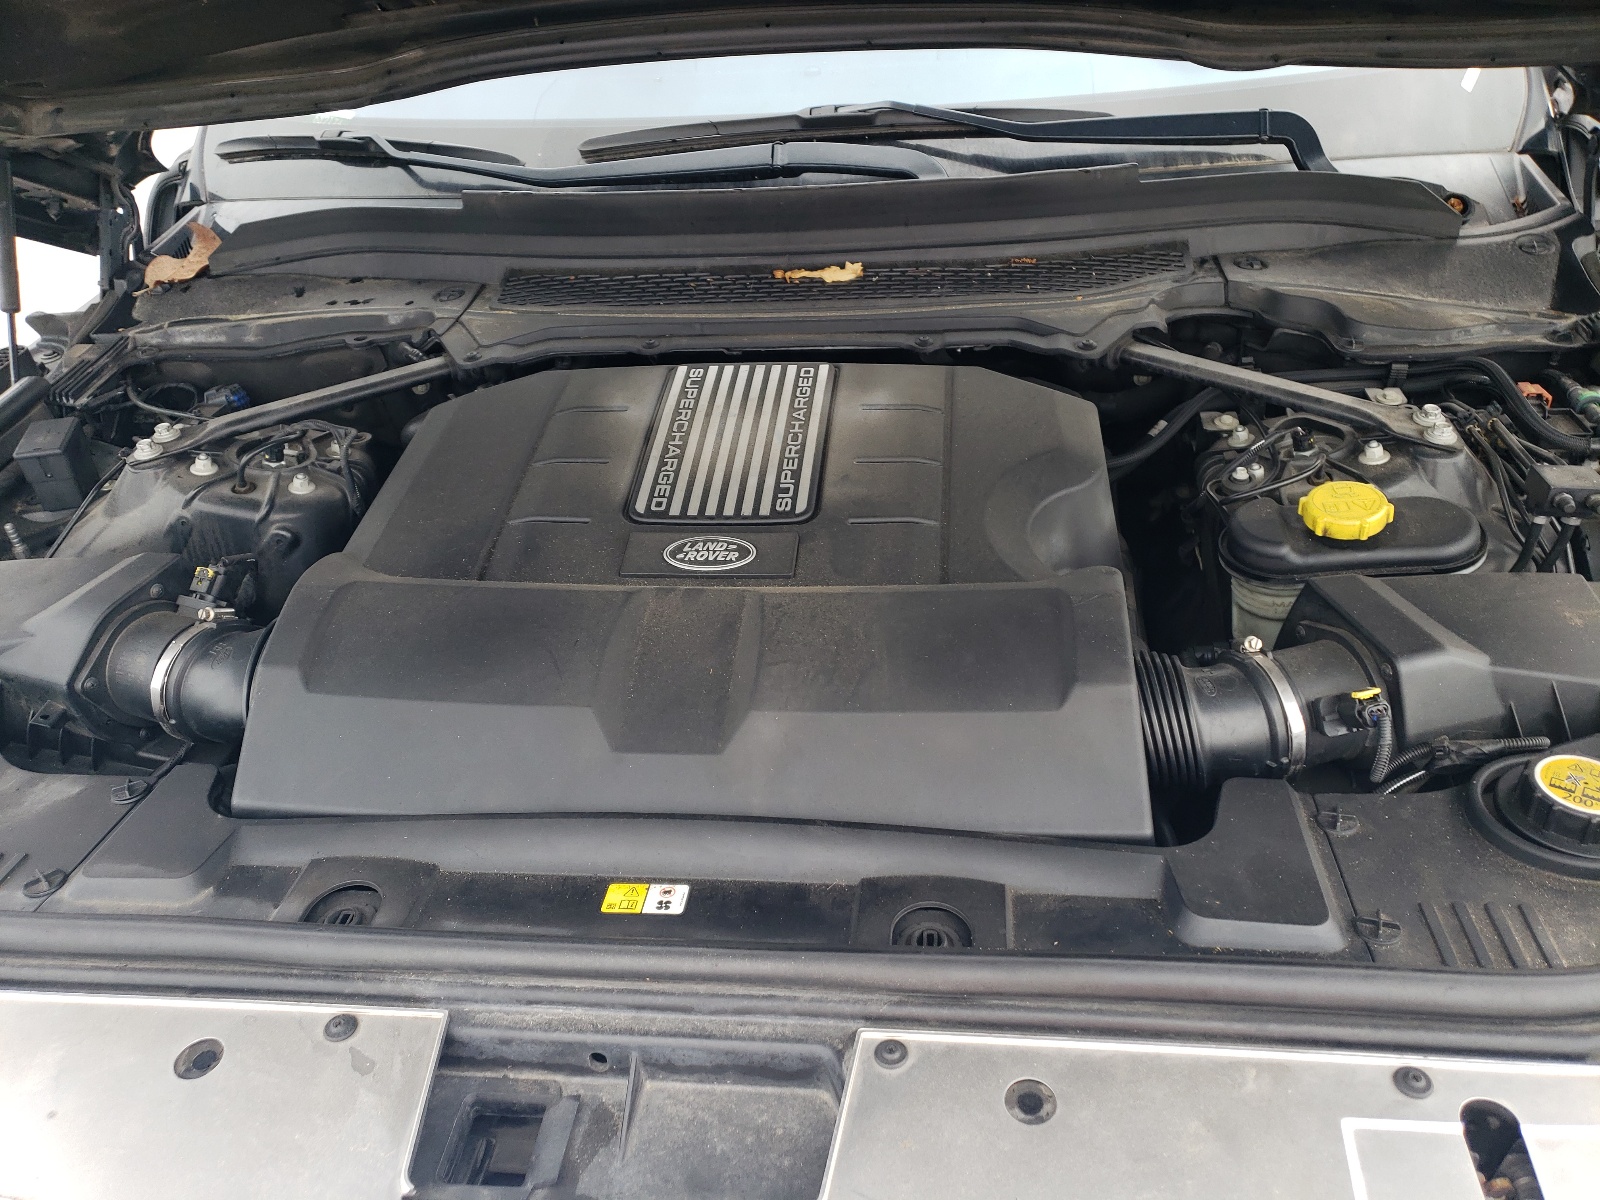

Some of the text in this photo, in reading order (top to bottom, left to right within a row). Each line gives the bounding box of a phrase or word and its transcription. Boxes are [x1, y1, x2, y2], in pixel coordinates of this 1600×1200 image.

[650, 367, 704, 512] SUPERCHARGED
[775, 366, 815, 512] SUPERCHARGED
[684, 551, 739, 561] ROVER
[1561, 792, 1594, 807] 200
